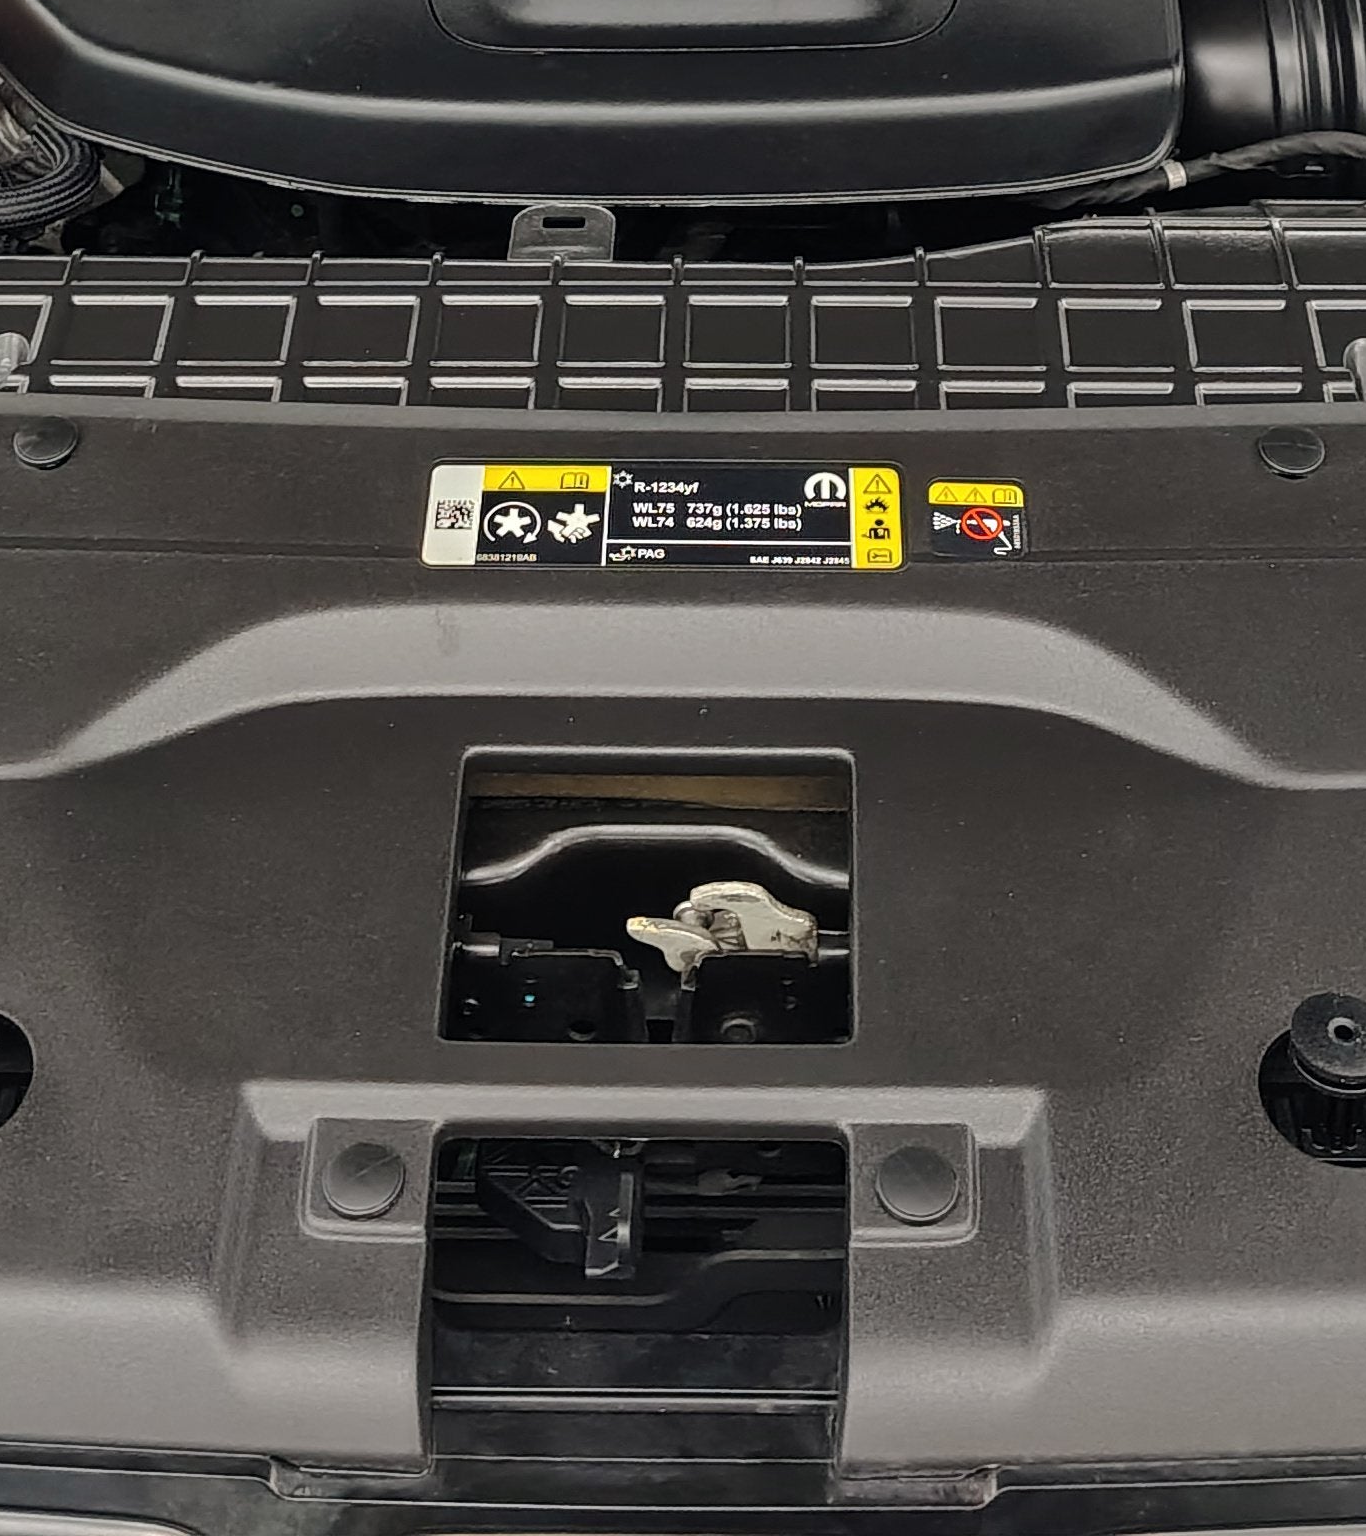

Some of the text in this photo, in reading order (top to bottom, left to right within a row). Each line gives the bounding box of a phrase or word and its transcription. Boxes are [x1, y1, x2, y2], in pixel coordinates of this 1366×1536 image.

[633, 481, 700, 495] R-1234yf
[632, 502, 803, 518] WL75 737g (1.625 lbs)
[631, 516, 804, 532] WL74 624g (1.375 lbs)
[636, 547, 666, 560] PAG
